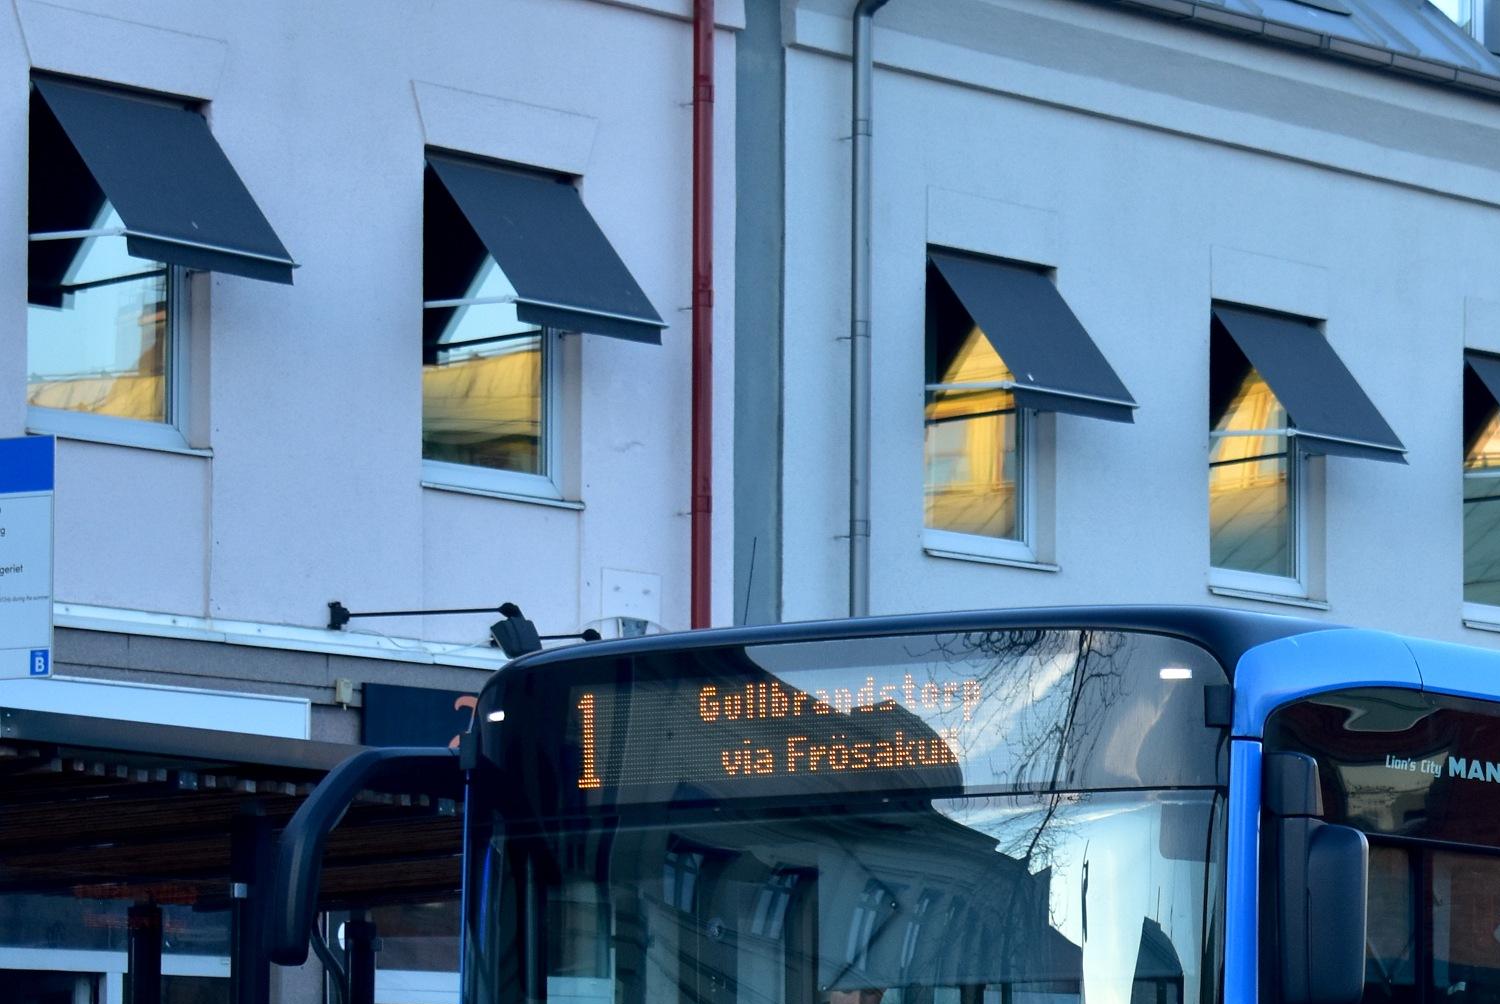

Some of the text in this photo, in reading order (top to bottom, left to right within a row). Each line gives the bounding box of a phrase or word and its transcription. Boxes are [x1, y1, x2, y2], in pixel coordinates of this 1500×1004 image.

[35, 656, 45, 673] B
[577, 673, 980, 789] 1 Gullbrandstorp
[722, 728, 958, 776] via Frösakull
[1385, 754, 1417, 772] Lion's
[1420, 759, 1442, 778] City
